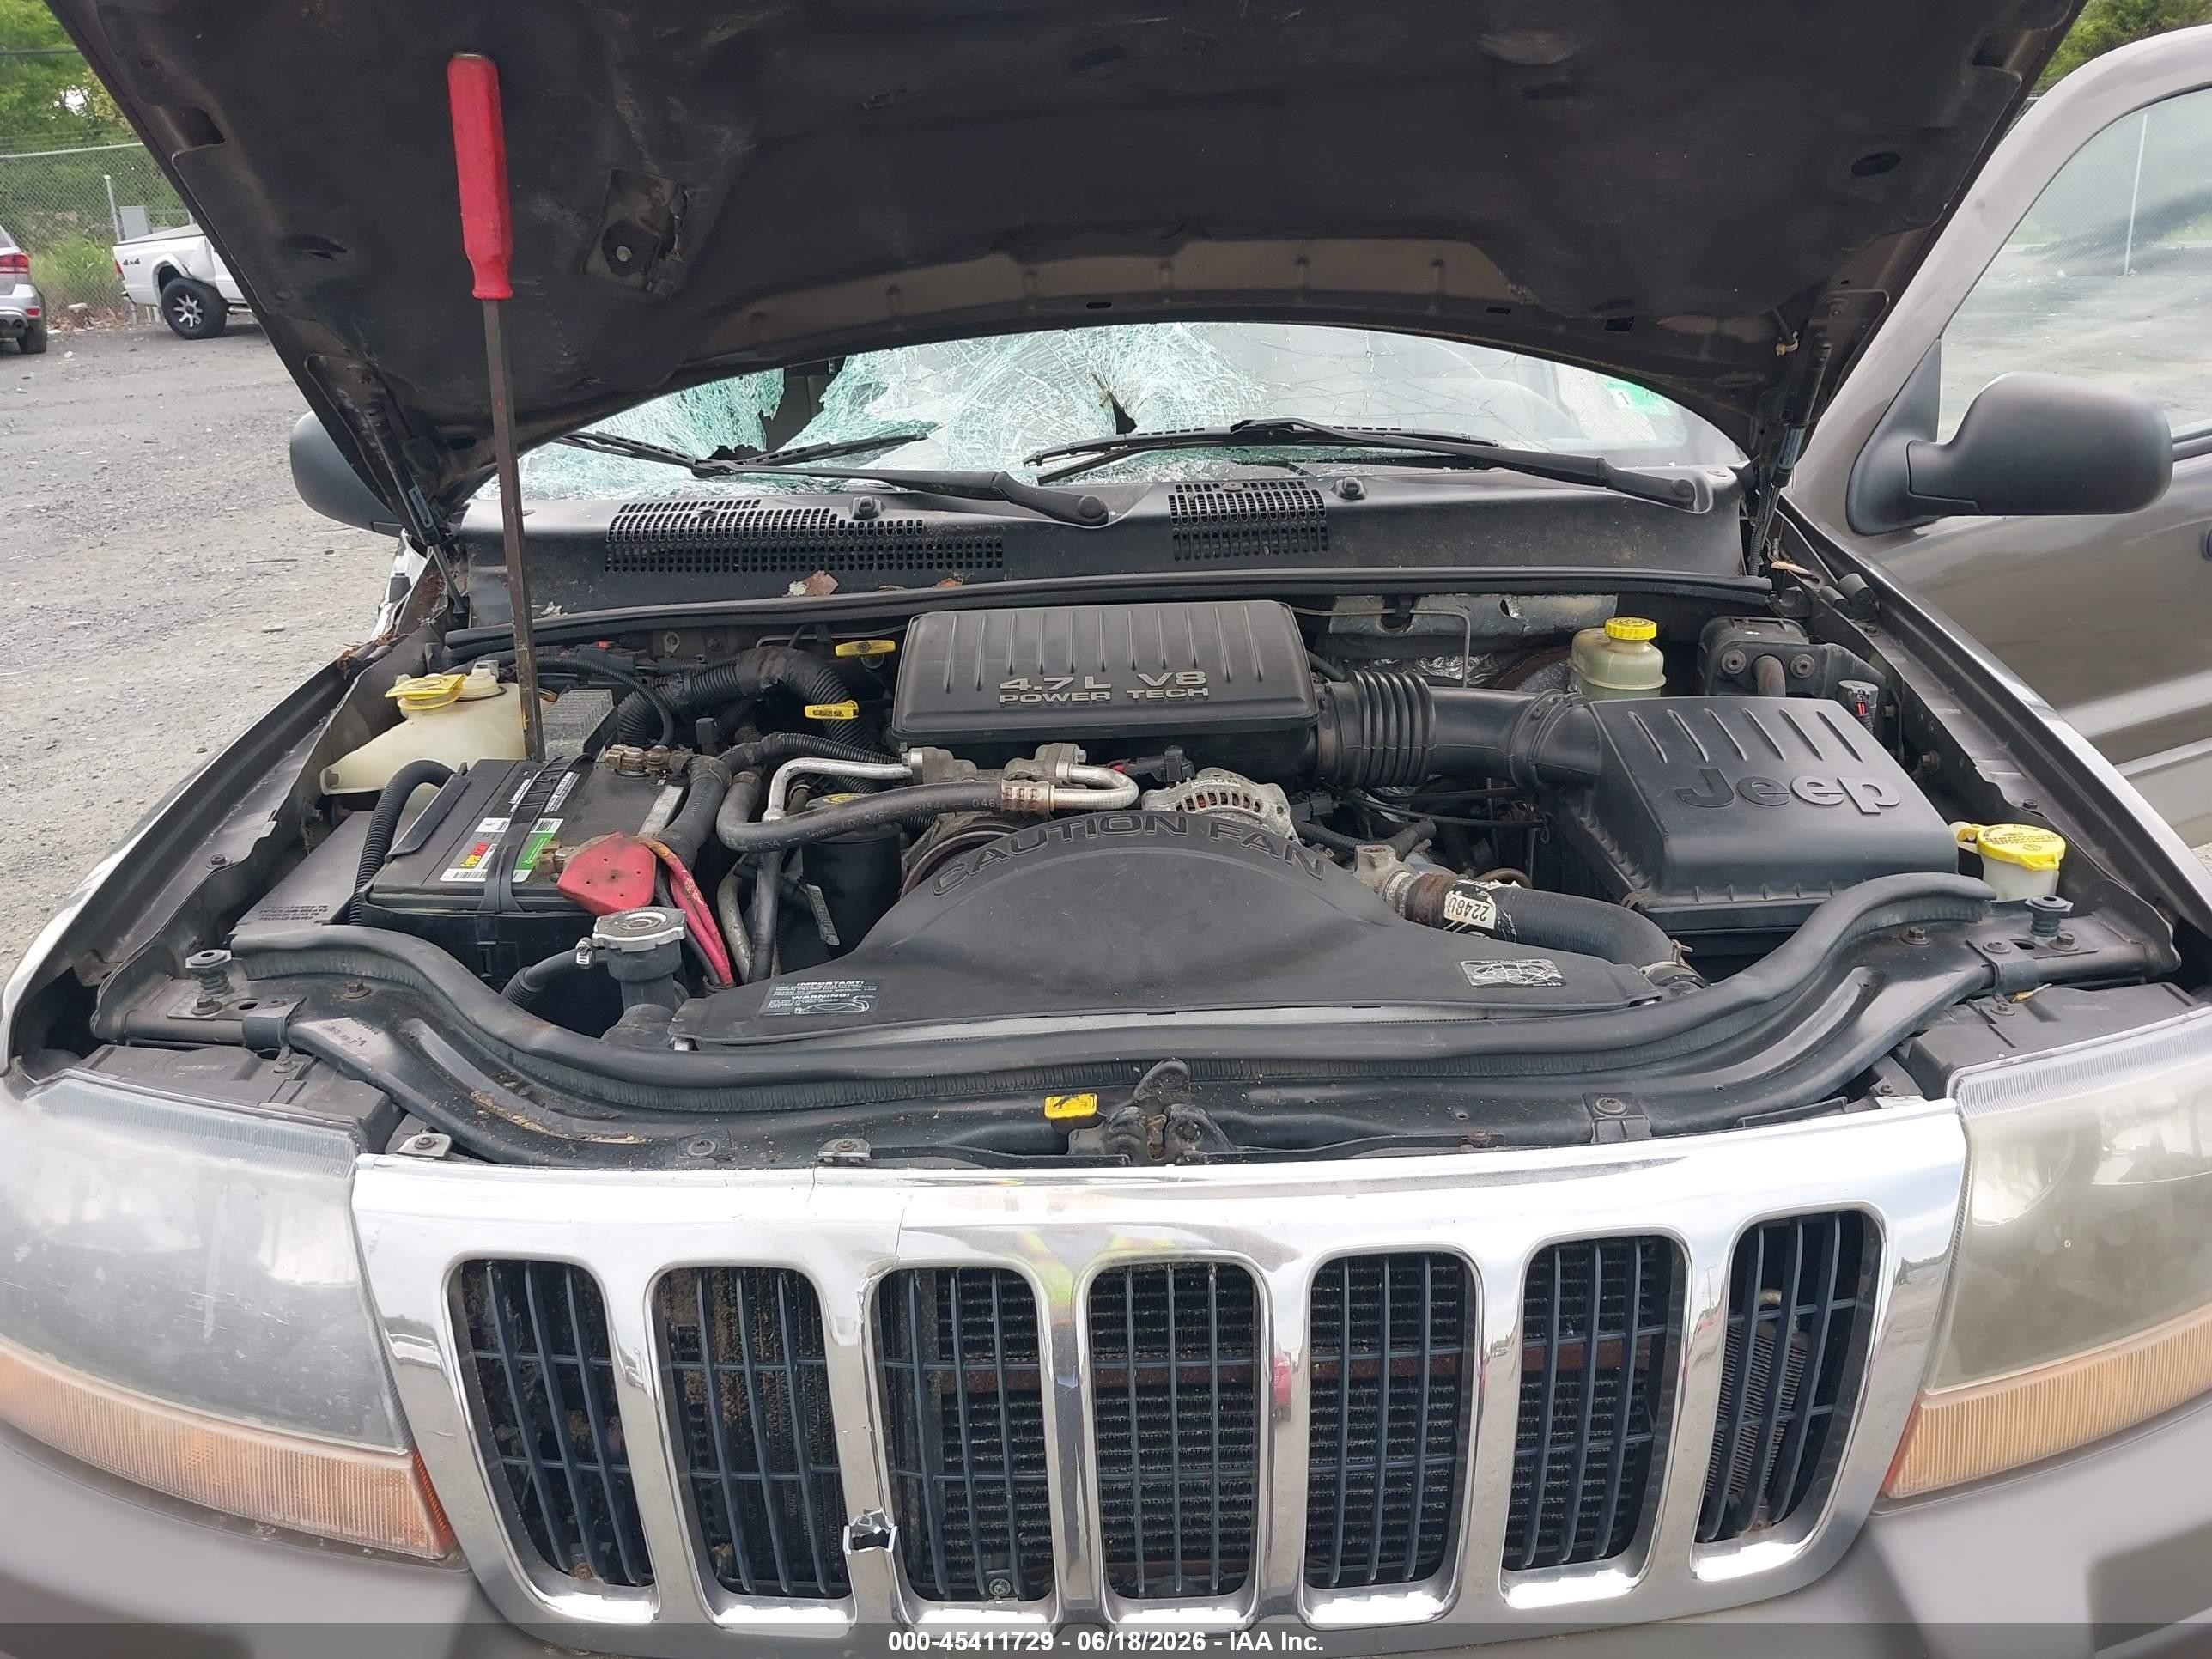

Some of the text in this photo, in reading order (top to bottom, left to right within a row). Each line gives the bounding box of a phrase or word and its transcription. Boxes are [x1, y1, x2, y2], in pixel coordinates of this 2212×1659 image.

[123, 258, 141, 266] 4x4
[1137, 671, 1207, 687] V8
[999, 687, 1209, 703] POWER TECH
[1675, 768, 1901, 816] Jeep
[932, 814, 1324, 896] CAUTION FAN
